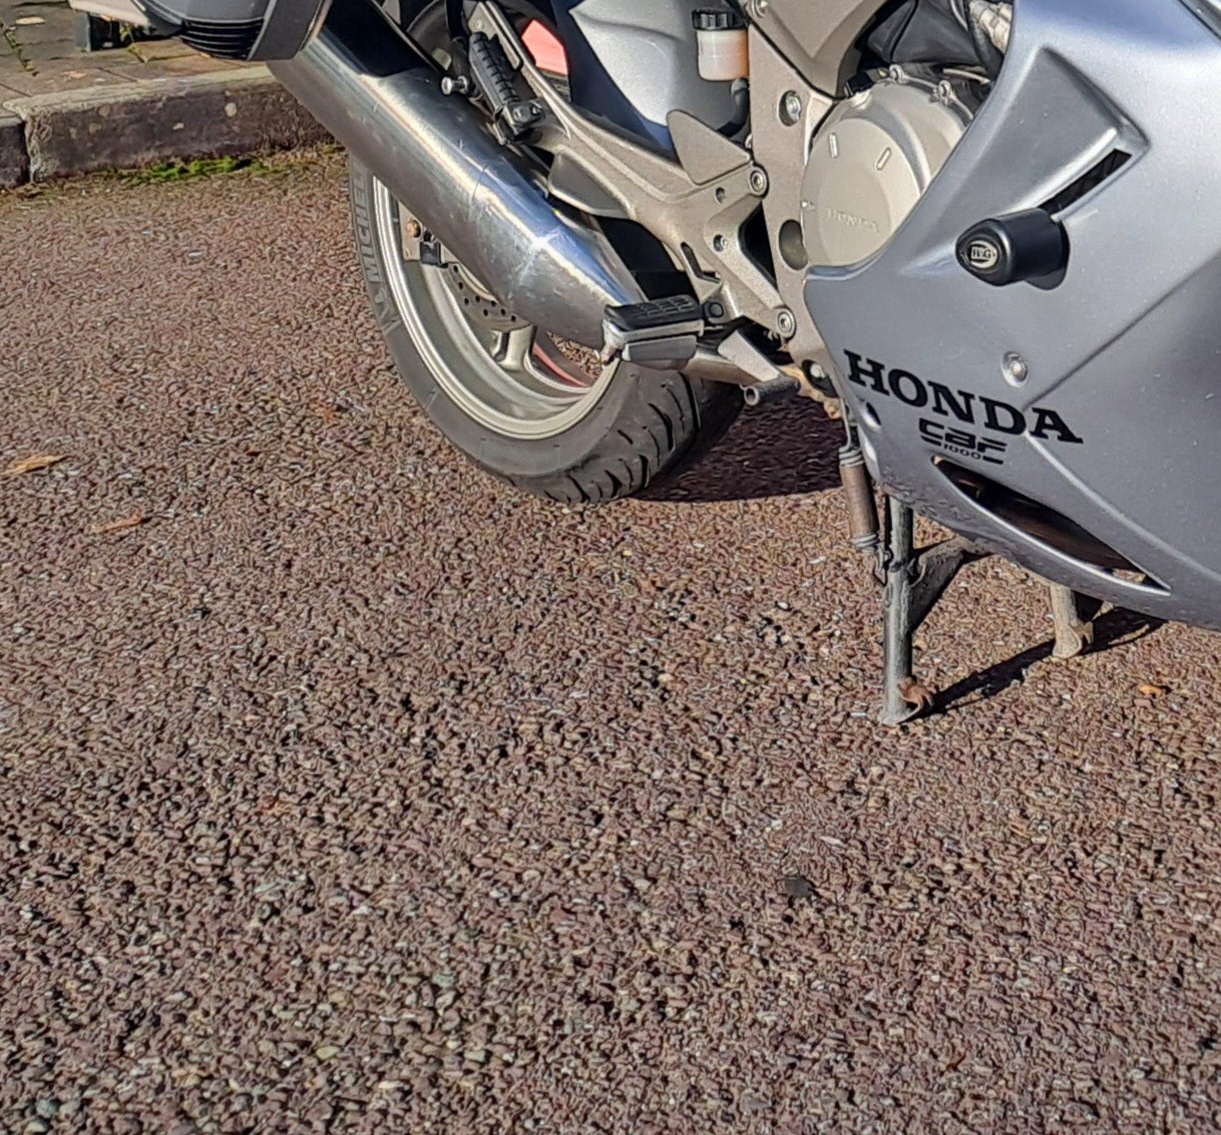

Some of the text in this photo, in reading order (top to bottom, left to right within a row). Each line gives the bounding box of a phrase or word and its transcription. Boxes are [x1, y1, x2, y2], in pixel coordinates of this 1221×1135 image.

[843, 348, 1084, 445] HONDA
[918, 417, 1008, 462] CBF
[943, 442, 983, 460] 1000
